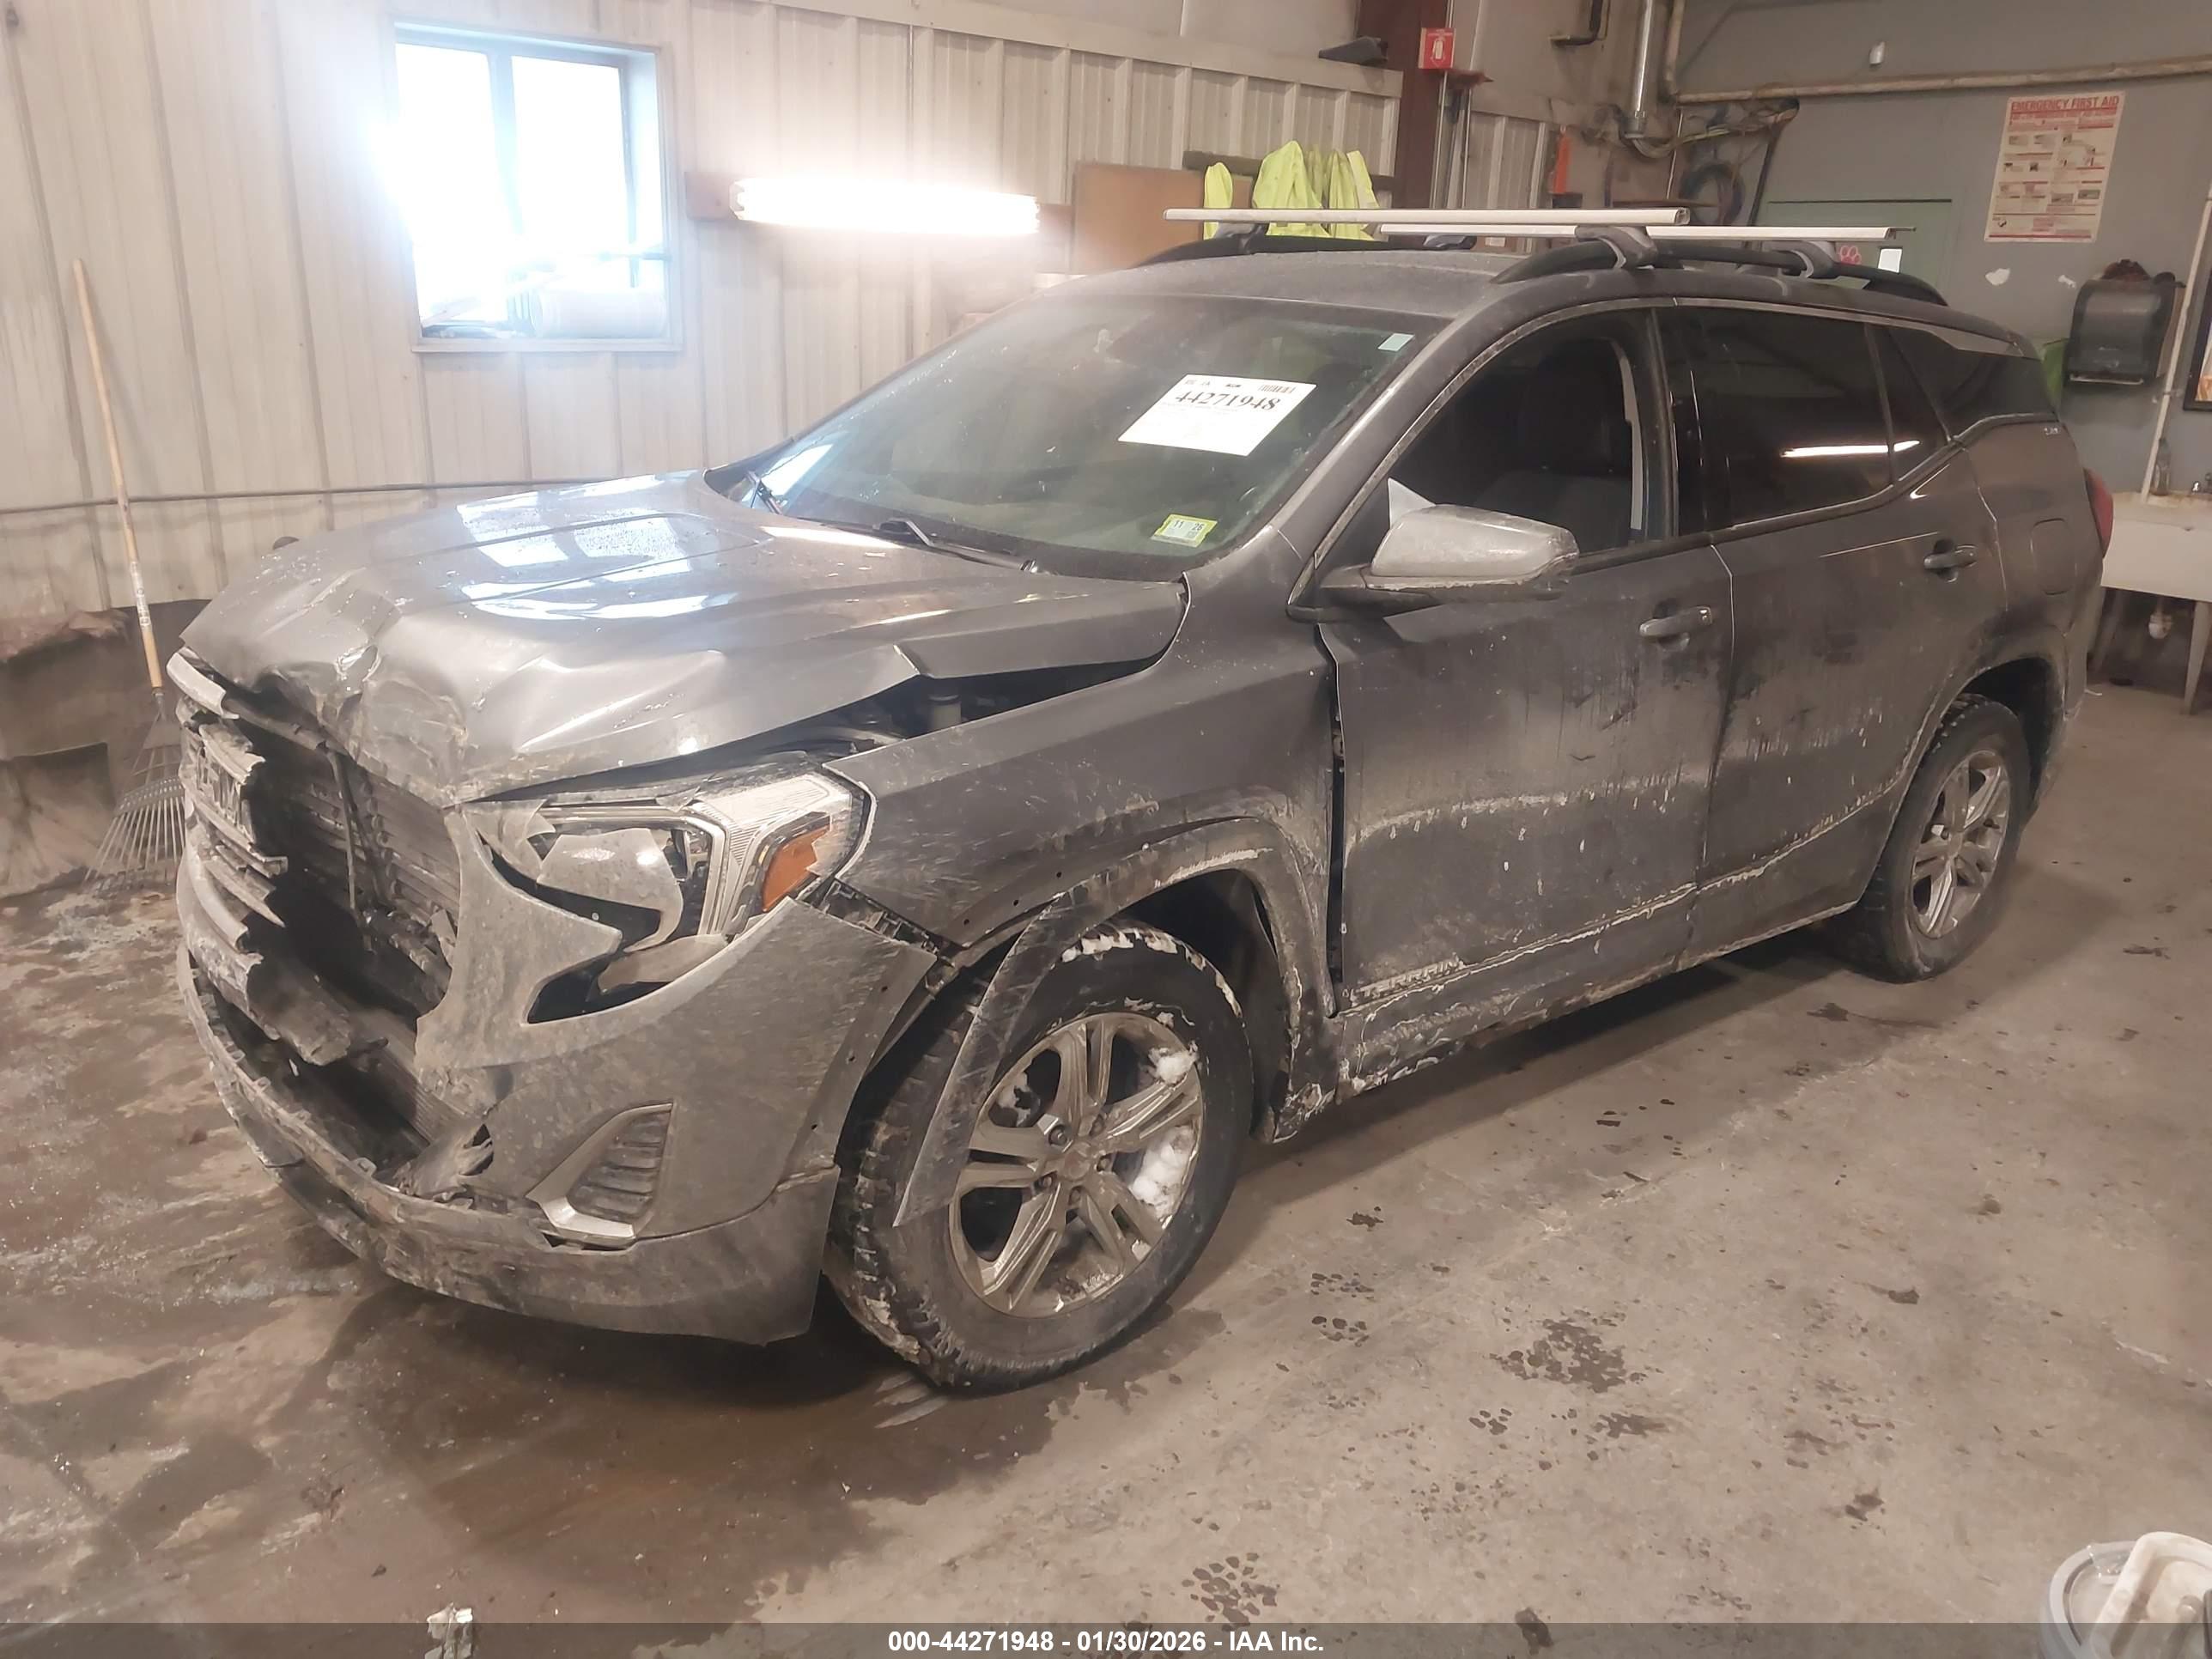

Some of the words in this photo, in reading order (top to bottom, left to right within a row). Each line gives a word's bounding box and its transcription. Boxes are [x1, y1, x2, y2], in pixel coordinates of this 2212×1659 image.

[2011, 99, 2069, 112] EMERGENCY
[2071, 96, 2099, 110] FIRST
[2101, 95, 2120, 108] AID
[1176, 391, 1280, 410] 44271948
[1174, 520, 1184, 529] 11
[1358, 959, 1459, 998] TERRAIN
